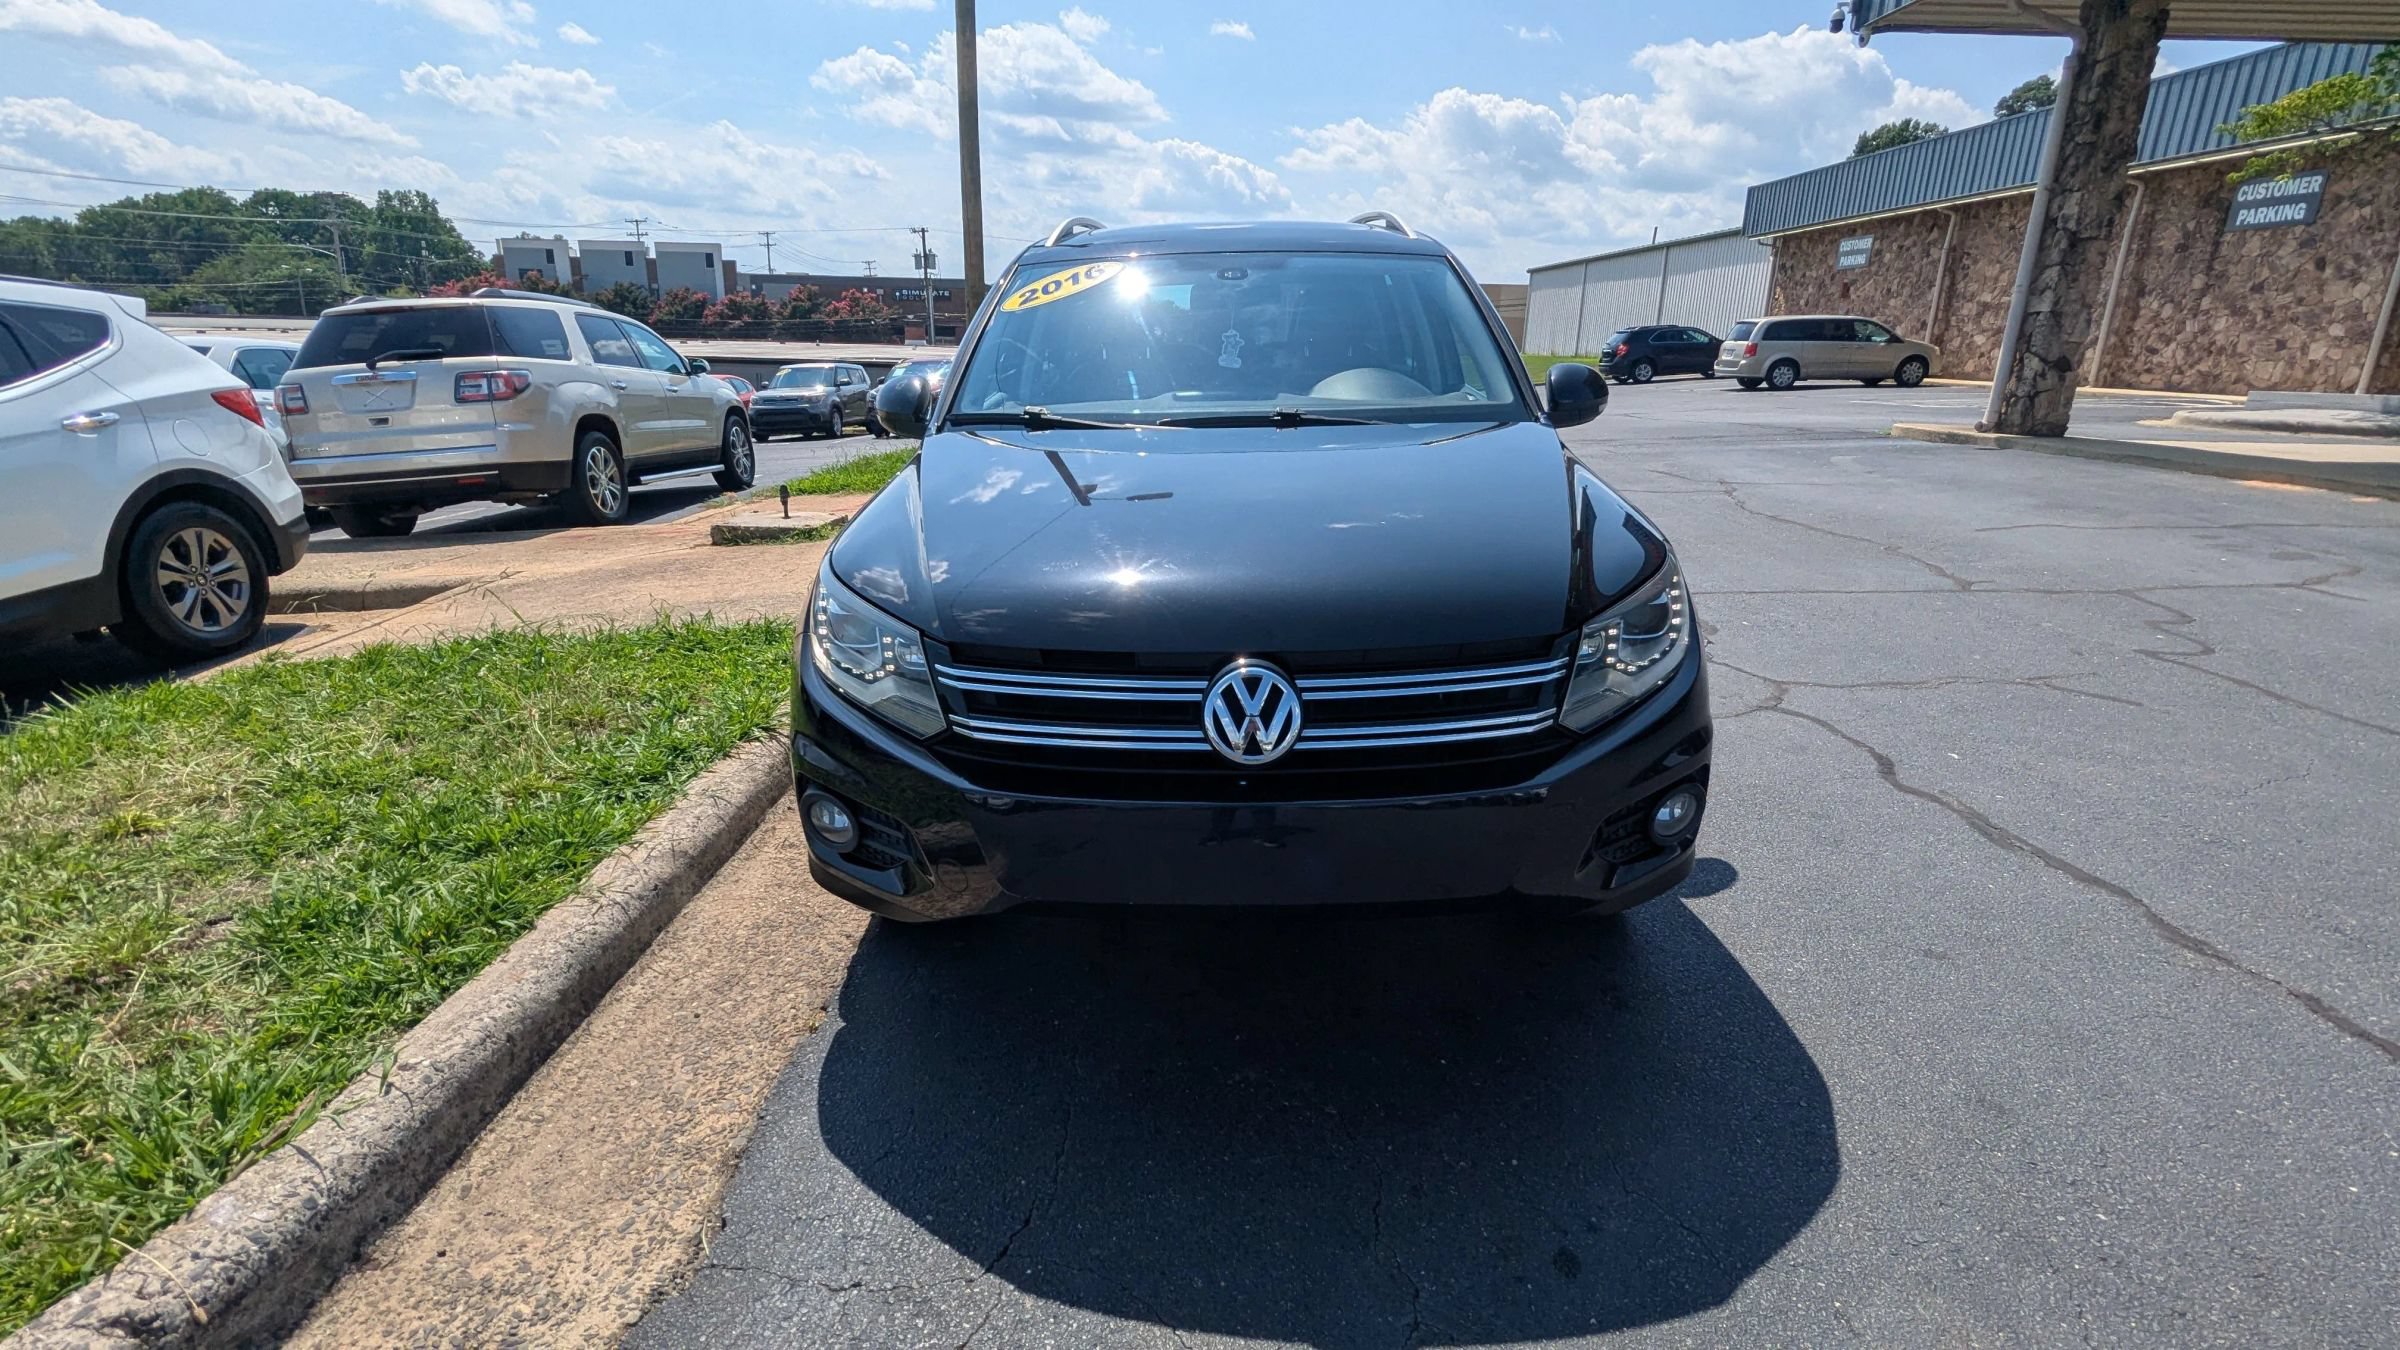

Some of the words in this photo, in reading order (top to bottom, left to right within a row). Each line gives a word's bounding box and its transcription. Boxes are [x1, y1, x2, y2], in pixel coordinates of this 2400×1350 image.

[2237, 175, 2323, 202] CUSTOMER
[2235, 202, 2307, 226] PARKING
[1840, 237, 1872, 251] CUSTOMER
[1840, 253, 1866, 267] PARKING
[902, 289, 950, 297] SIMUATE
[1018, 263, 1105, 307] 2016
[1203, 666, 1301, 765] VW
